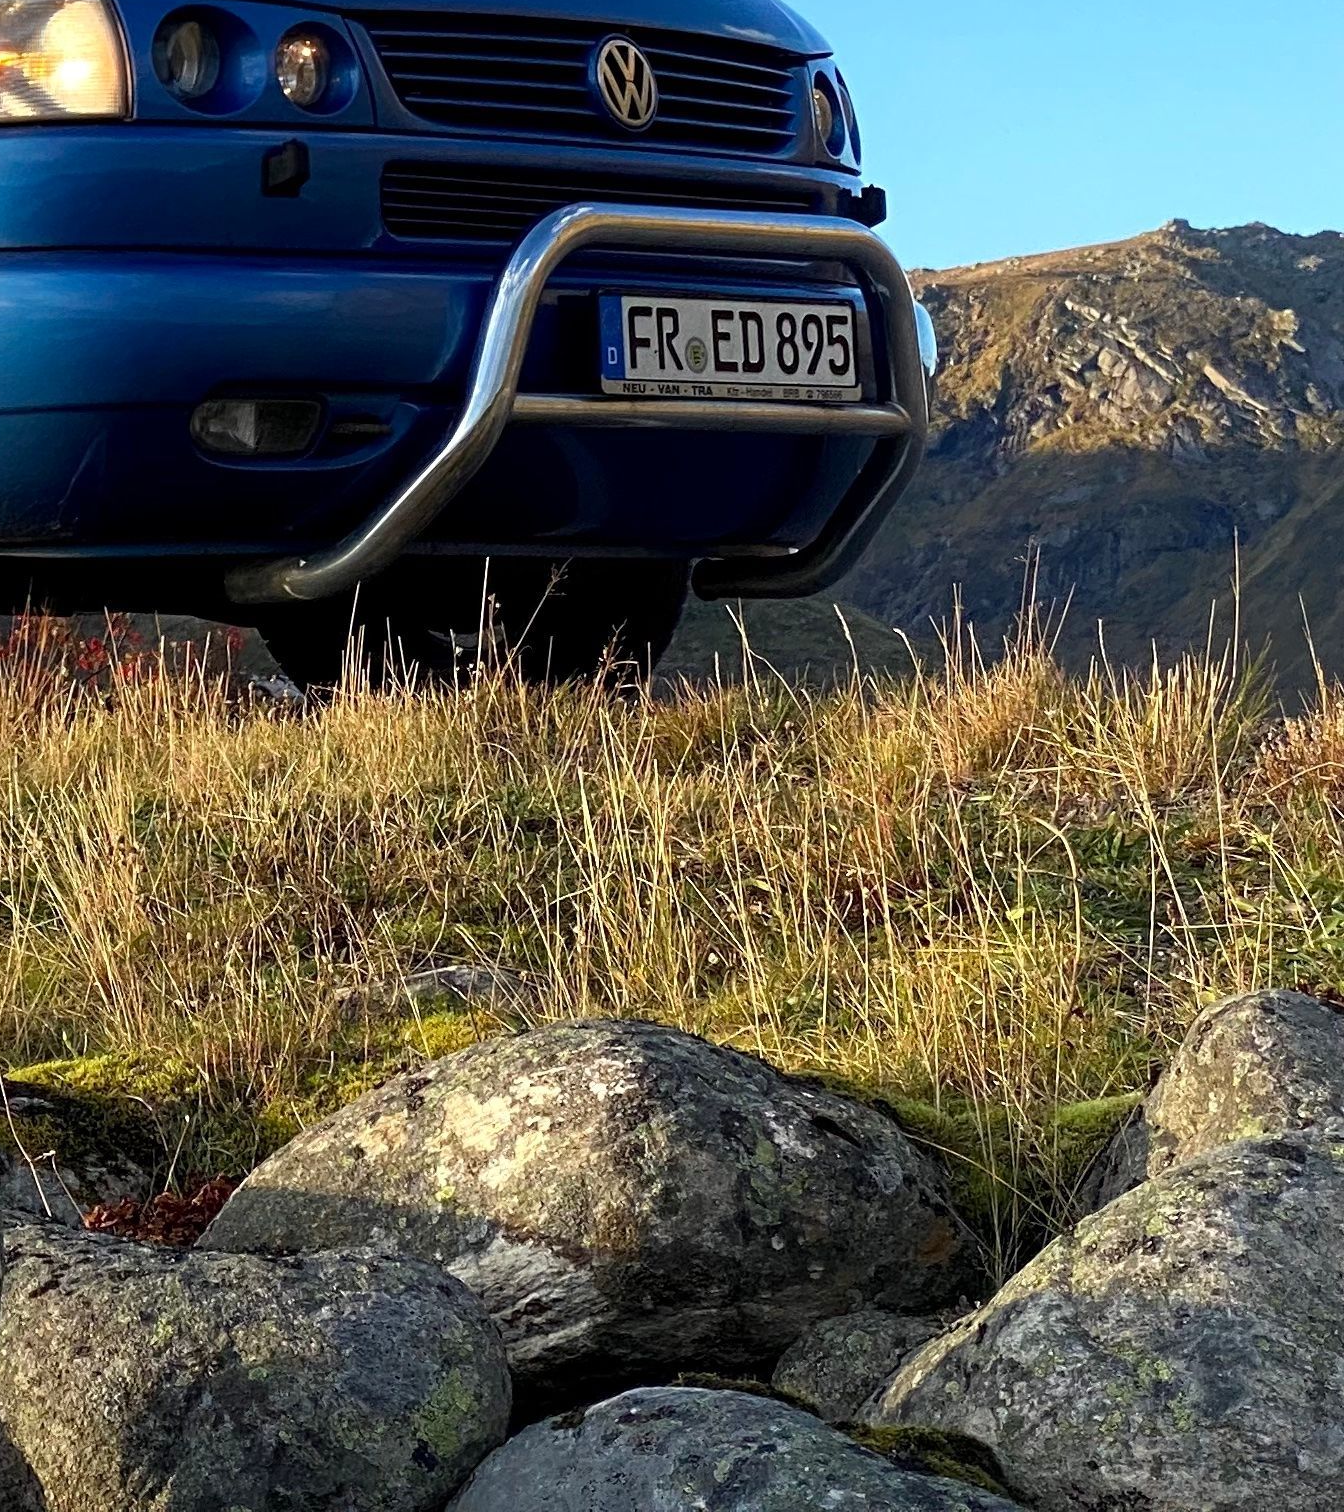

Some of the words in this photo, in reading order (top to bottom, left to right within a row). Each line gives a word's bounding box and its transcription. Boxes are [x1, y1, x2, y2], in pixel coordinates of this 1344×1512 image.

[597, 39, 655, 127] VW
[607, 346, 618, 365] D
[627, 305, 684, 371] FR
[711, 309, 766, 374] ED
[776, 311, 851, 376] 895
[622, 383, 646, 394] NEU
[657, 384, 680, 395] VAN
[692, 385, 713, 396] TRA
